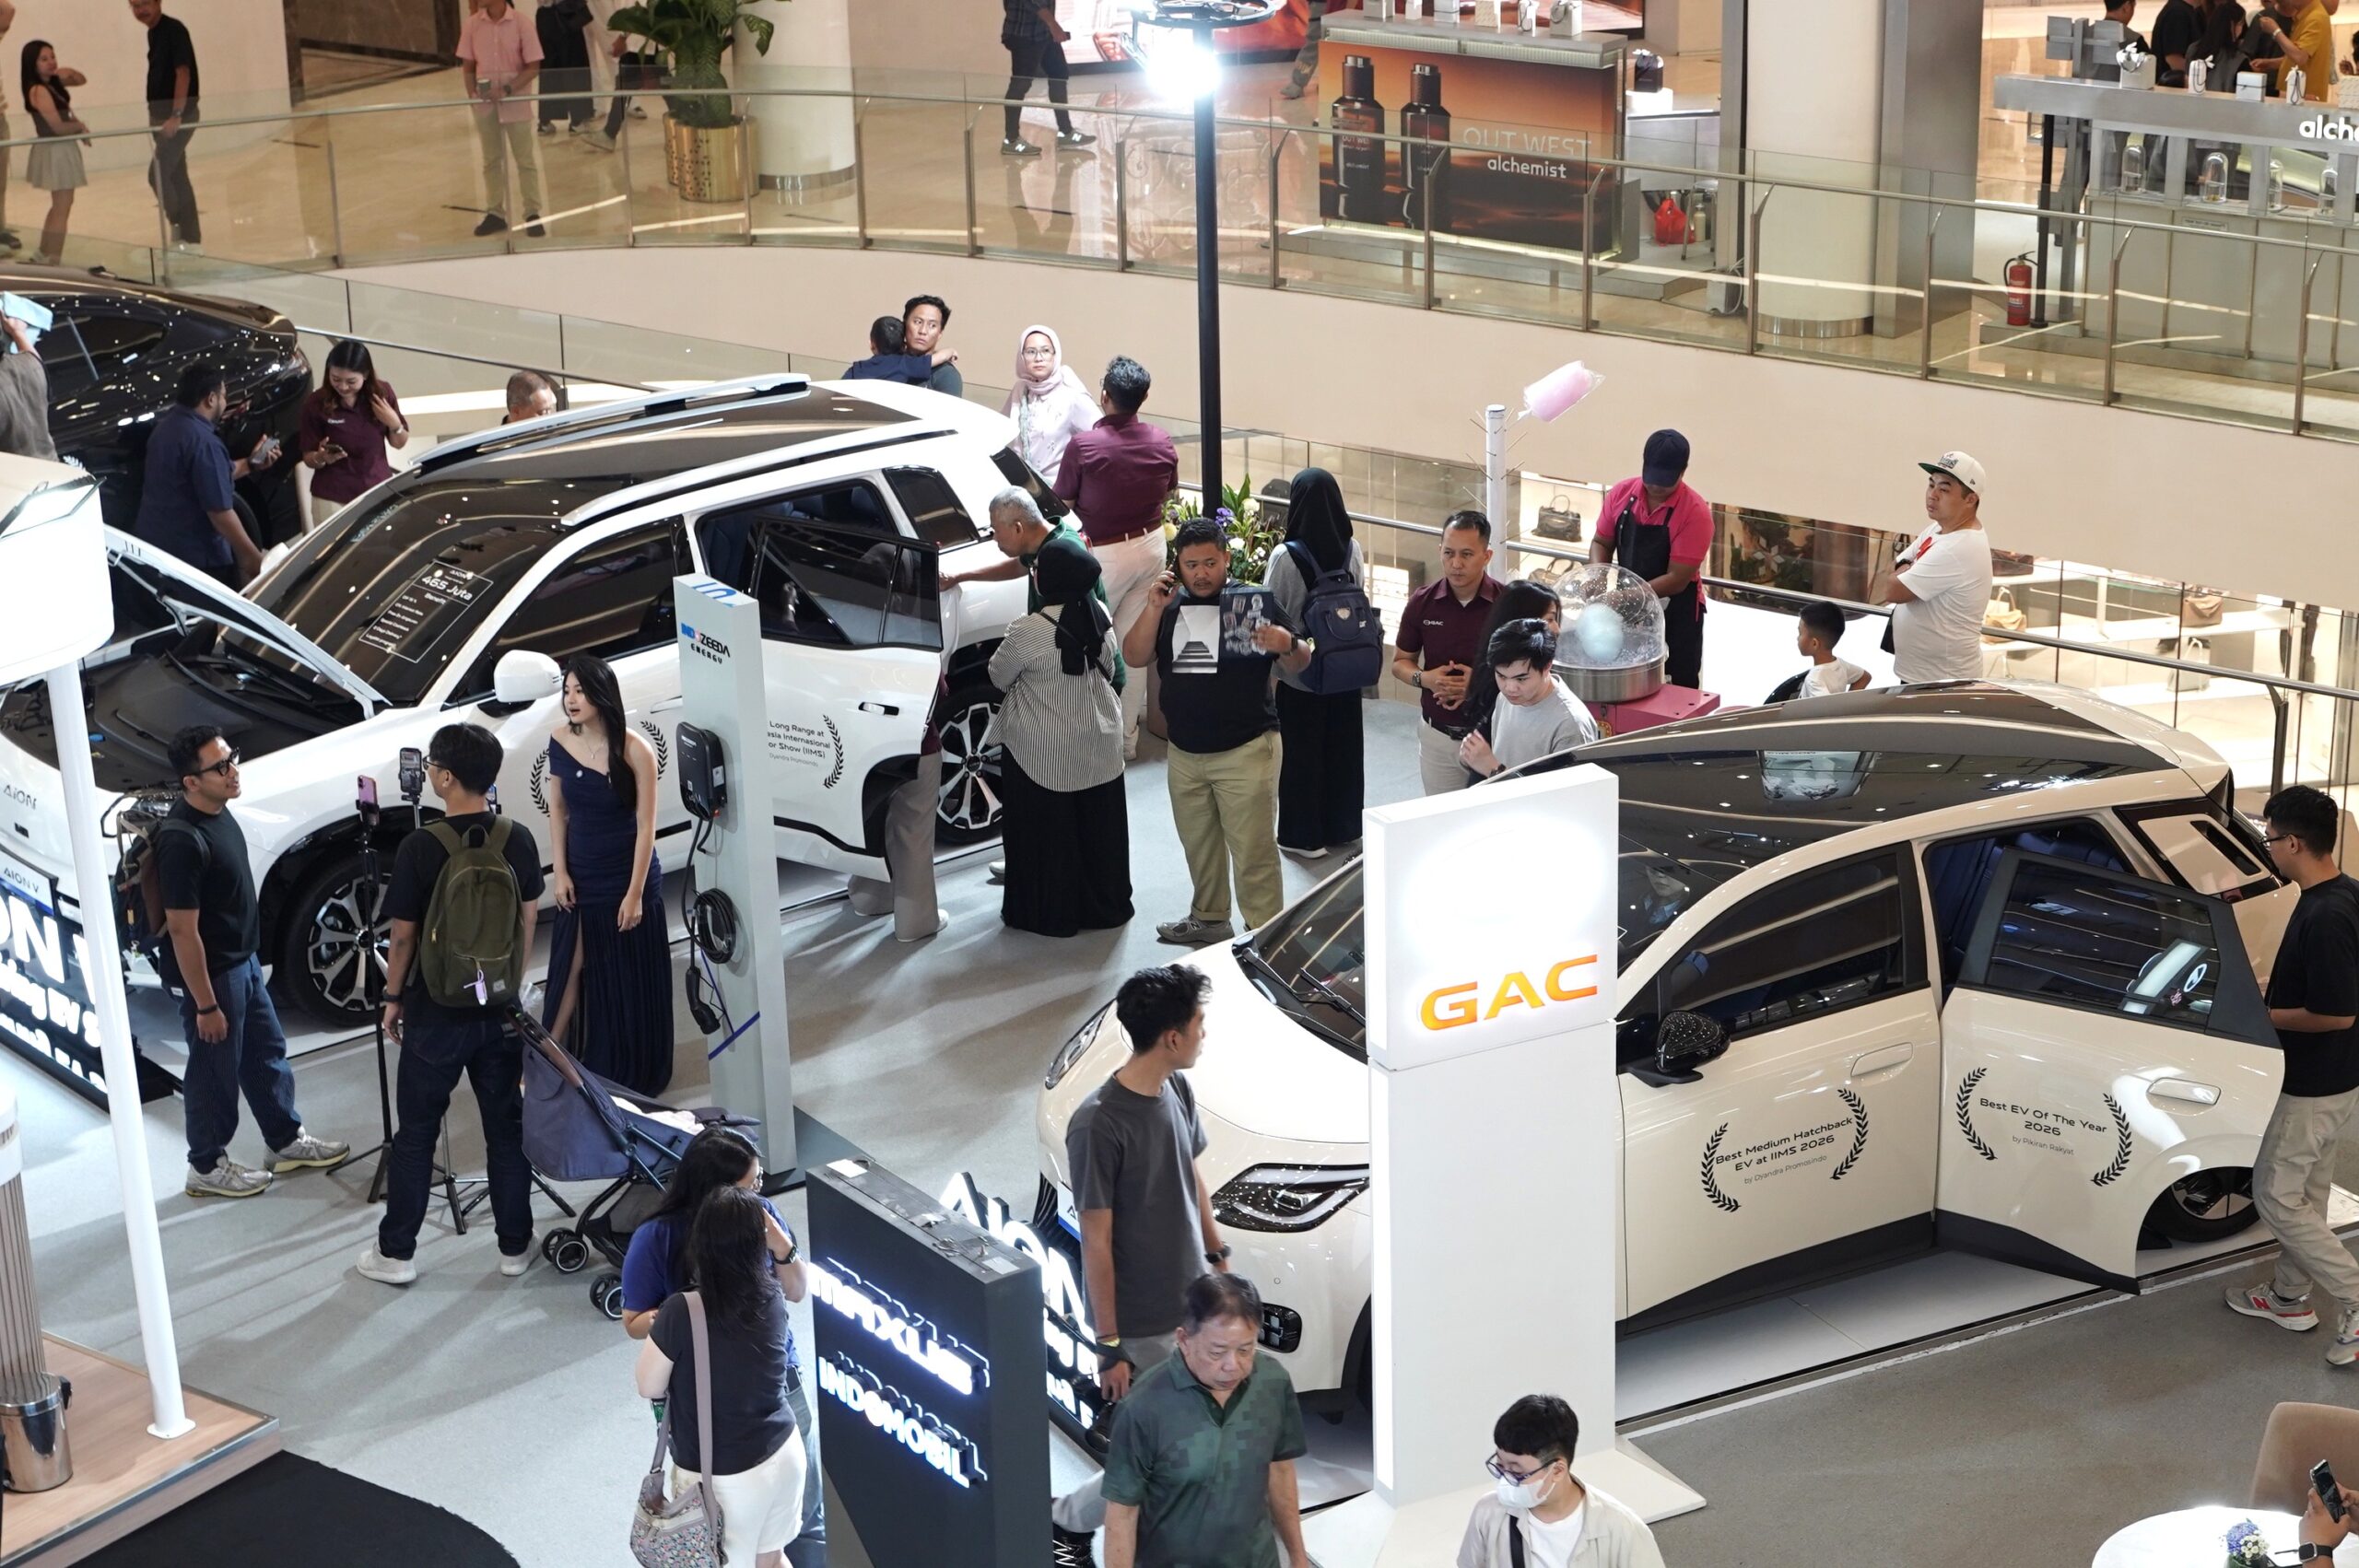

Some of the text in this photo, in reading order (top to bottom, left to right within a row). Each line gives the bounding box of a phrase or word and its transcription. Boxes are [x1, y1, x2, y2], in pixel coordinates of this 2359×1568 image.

[1462, 126, 1517, 149] OUT
[1487, 155, 1567, 179] alchemist
[422, 575, 449, 590] 465
[446, 585, 473, 601] Juta
[690, 642, 723, 664] ENERGY
[769, 720, 825, 738] Long Range at
[783, 731, 830, 749] Internasional
[779, 742, 801, 753] Show
[803, 746, 826, 759] (IIMS)
[4, 867, 31, 889] AION
[1420, 954, 1599, 1032] GAC
[1980, 1097, 2107, 1133] Best EV Of The Year
[2025, 1120, 2061, 1137] 2026
[1716, 1117, 1853, 1164] Best Medium Hatchback
[2013, 1136, 2074, 1156] by Pikiran Rakyat
[1735, 1134, 1835, 1172] EV at IIMS 2026
[1744, 1154, 1827, 1185] by Dyandra Promosindo
[818, 1356, 970, 1489] INDOMOBIL
